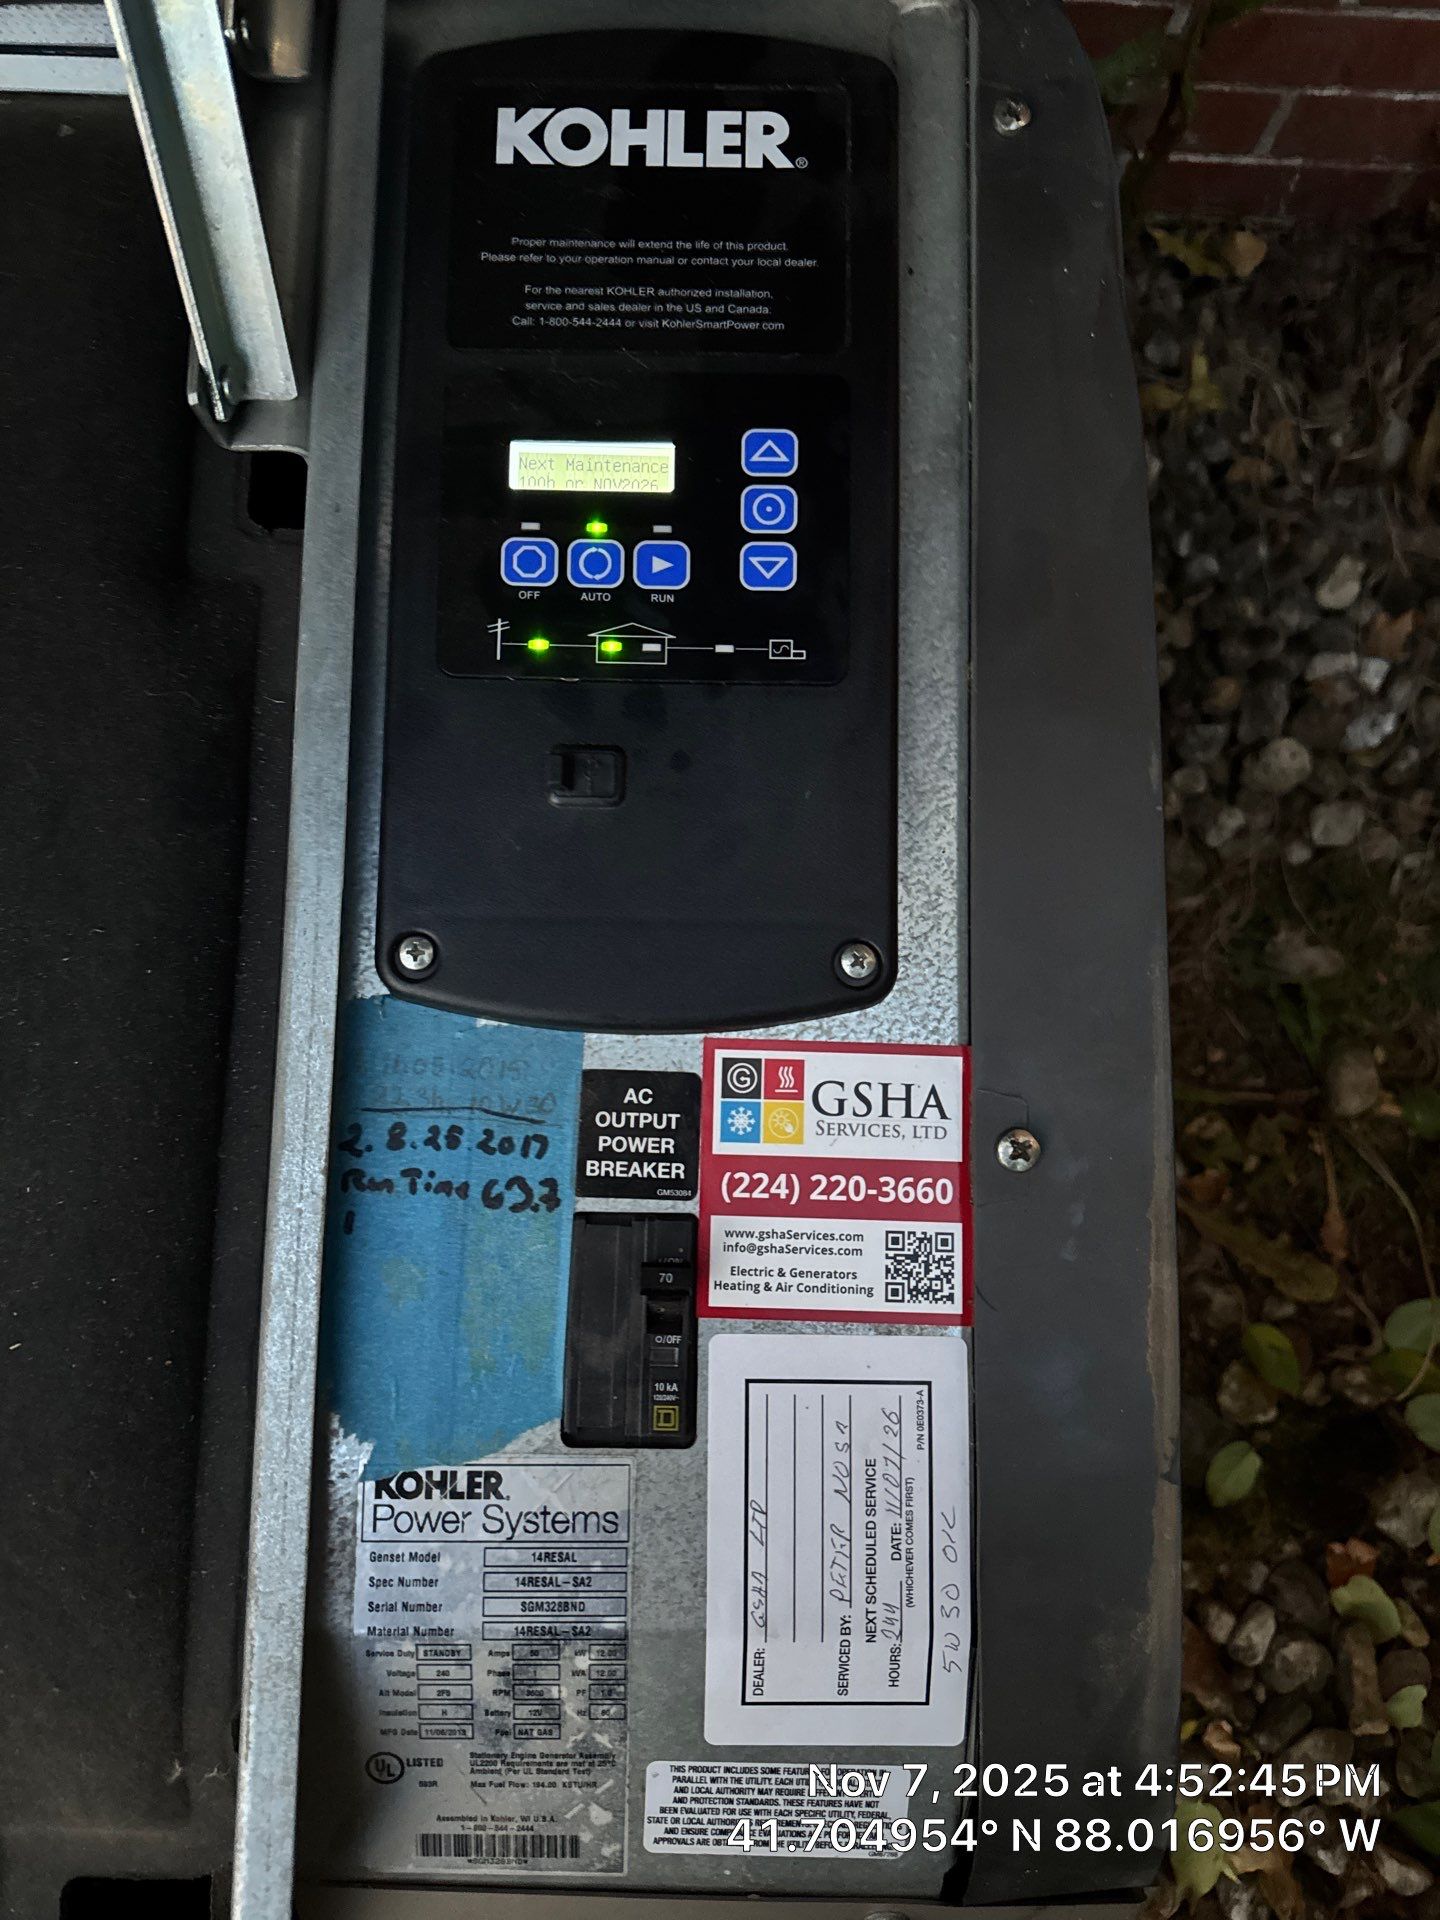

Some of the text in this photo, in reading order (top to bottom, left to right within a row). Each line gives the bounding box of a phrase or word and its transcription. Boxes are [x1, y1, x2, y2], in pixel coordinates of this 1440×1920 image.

[511, 237, 788, 252] Proper maintenance will extend the life of this product.
[481, 252, 819, 268] Please refer to your operation manual or contact your local dealer.
[525, 284, 773, 299] For the nearest KOHLER authorized installation,
[525, 301, 562, 311] service
[565, 302, 584, 311] and
[588, 302, 616, 312] sales
[618, 303, 651, 312] dealer
[654, 304, 663, 312] in
[666, 303, 683, 312] the
[686, 304, 702, 313] US
[705, 304, 724, 313] and
[512, 316, 535, 326] Call:
[539, 317, 621, 328] 1-800-544-2444
[625, 319, 635, 327] or
[639, 319, 659, 328] visit
[519, 457, 669, 474] Next Maintenance
[520, 475, 555, 489] 100h
[565, 479, 583, 489] or
[518, 590, 675, 603] OFF AUTO RUN
[623, 1088, 653, 1104] AC
[812, 1080, 952, 1120] GSHA
[595, 1112, 681, 1129] OUTPUT
[815, 1120, 948, 1141] SERVICES, LTD
[598, 1136, 675, 1154] POWER
[586, 1161, 685, 1179] BREAKER
[721, 1172, 954, 1205] (224) 220-3660
[724, 1228, 864, 1243] www.gshaServices.com
[722, 1242, 863, 1257] info@gshaServices.com
[659, 1272, 673, 1283] 70
[730, 1266, 858, 1280] Electric & Generators
[713, 1280, 874, 1298] Heating & Air Conditioning
[654, 1382, 678, 1392] 10 kA
[916, 1433, 925, 1450] P/N
[374, 1470, 506, 1500] KOHLER
[372, 1504, 619, 1540] Power Systems
[890, 1523, 902, 1561] DATE:
[904, 1477, 915, 1608] (WHICHEVER COMES FIRST)
[369, 1551, 577, 1563] Genset Model 14RESAL
[865, 1458, 877, 1643] NEXT SCHEDULED SERVICE
[368, 1576, 394, 1589] Spec
[399, 1576, 439, 1588] Number
[367, 1601, 398, 1613] Serial
[401, 1602, 443, 1613] Number
[366, 1626, 409, 1637] Material
[413, 1626, 455, 1637] Number
[837, 1614, 852, 1696] SERVICED BY:
[753, 1648, 765, 1696] DEALER:
[888, 1643, 901, 1688] HOURS:
[406, 1757, 444, 1768] LISTED
[670, 1764, 781, 1775] THIS PRODUCT INCLUDES SOME
[672, 1775, 708, 1784] PARALLEL
[709, 1776, 728, 1785] WITH
[730, 1777, 743, 1785] THE
[774, 1778, 794, 1786] EACH
[673, 1796, 880, 1809] AND PROTECTION STANDARDS. THESE FEATURES HAVE NOT
[659, 1806, 678, 1814] BEEN
[680, 1807, 720, 1816] EVALUATED
[722, 1808, 736, 1816] FOR
[738, 1808, 752, 1816] USE
[754, 1809, 772, 1817] WITH
[774, 1809, 793, 1817] EACH
[795, 1809, 827, 1818] SPECIFIC
